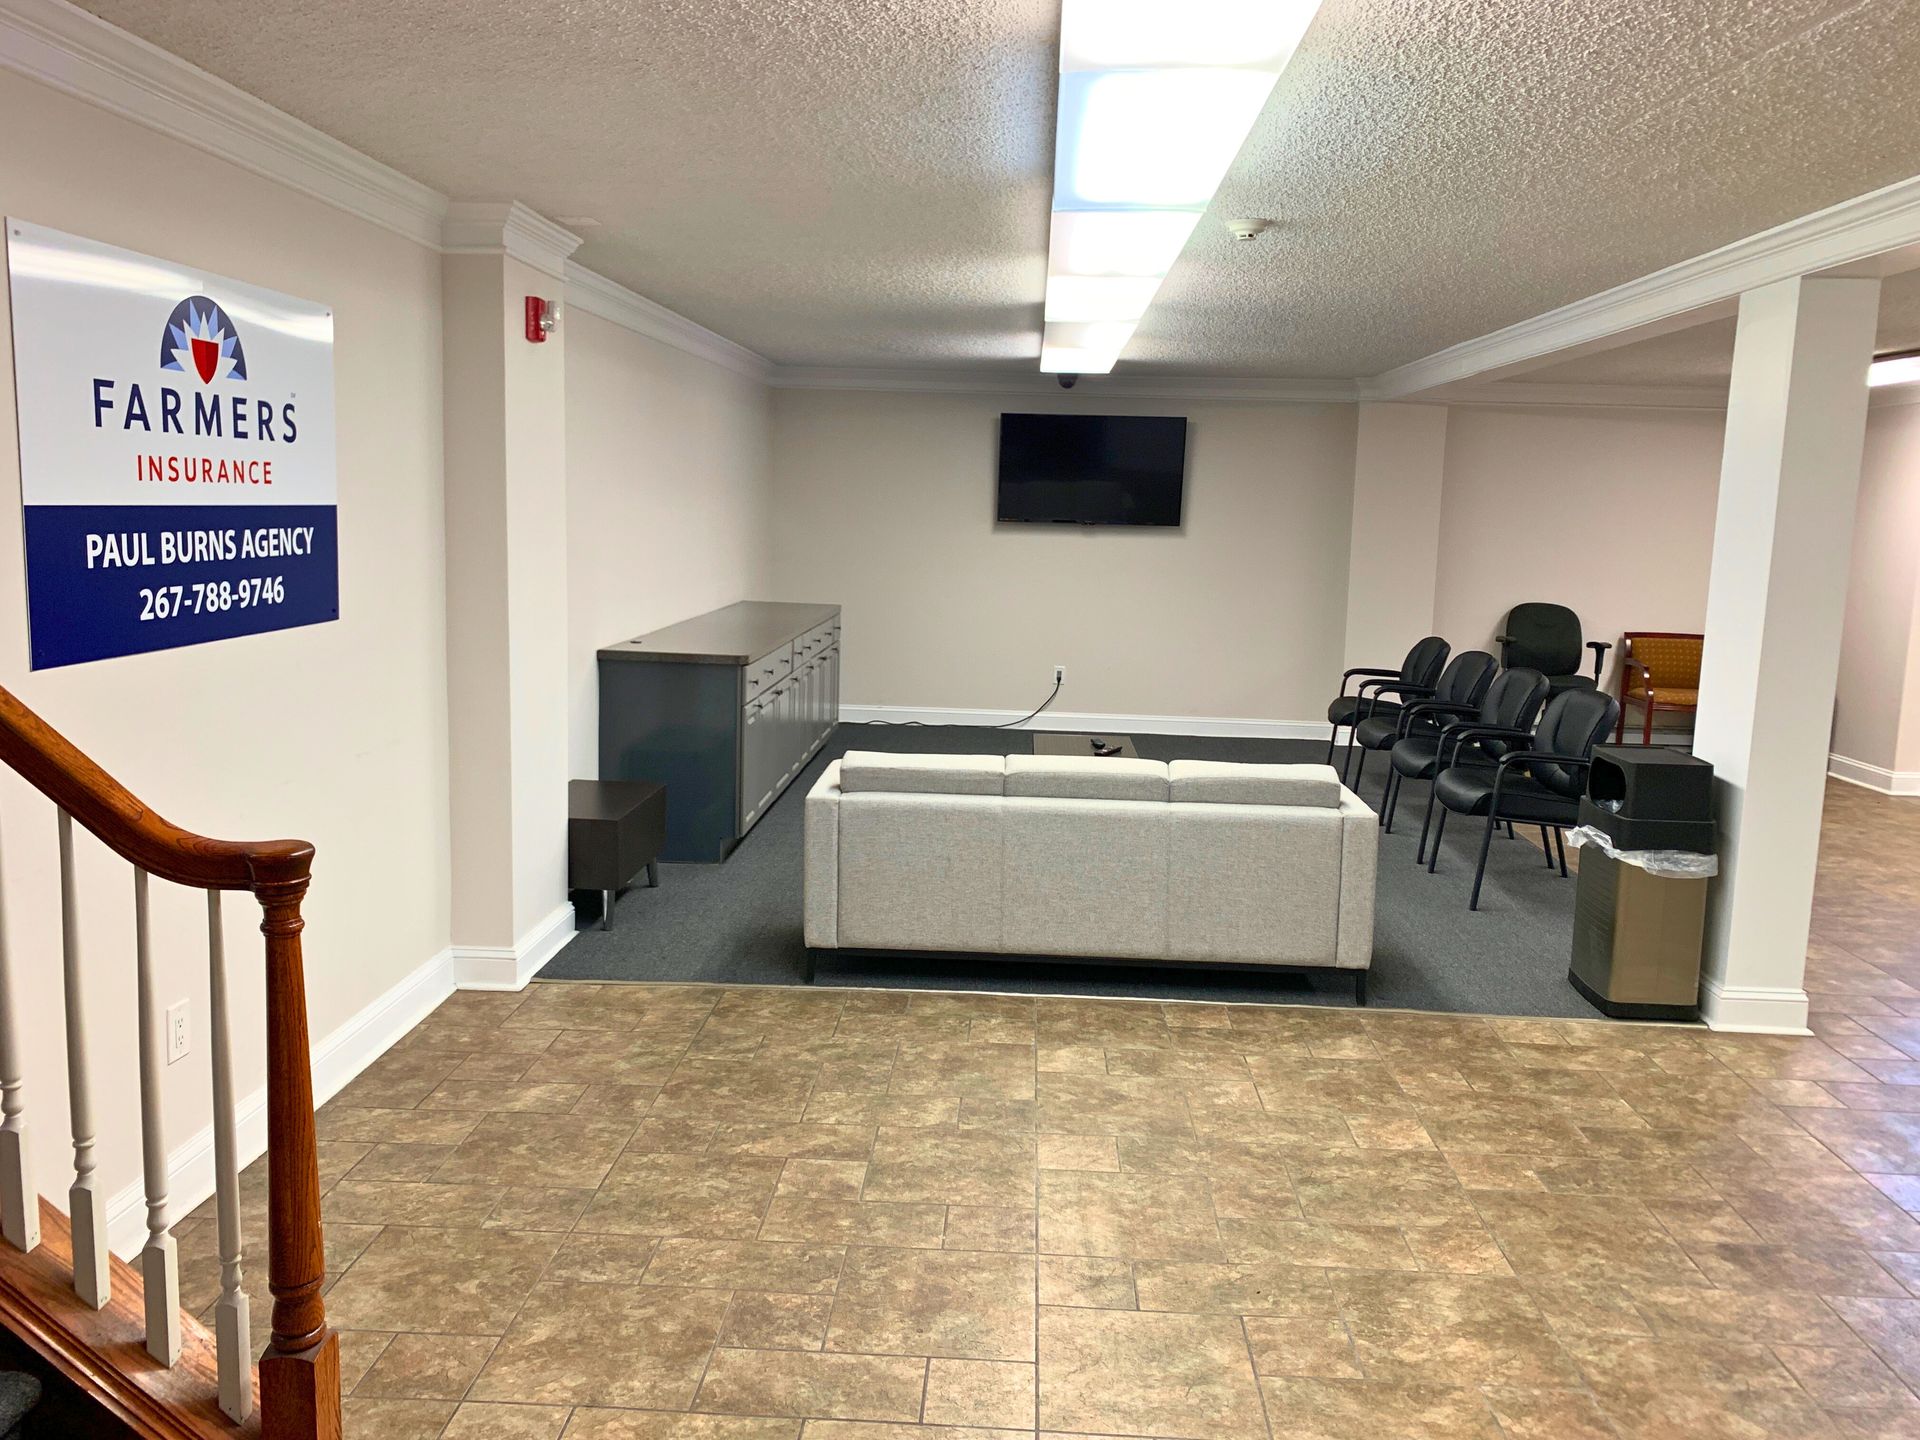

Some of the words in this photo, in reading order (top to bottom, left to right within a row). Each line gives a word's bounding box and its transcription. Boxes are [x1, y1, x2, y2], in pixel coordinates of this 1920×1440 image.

[93, 378, 297, 443] FARMERS
[137, 455, 272, 485] INSURANCE
[86, 532, 155, 569] PAUL
[161, 529, 237, 564] BURNS
[241, 526, 314, 559] AGENCY
[139, 575, 285, 621] 267-788-9746
